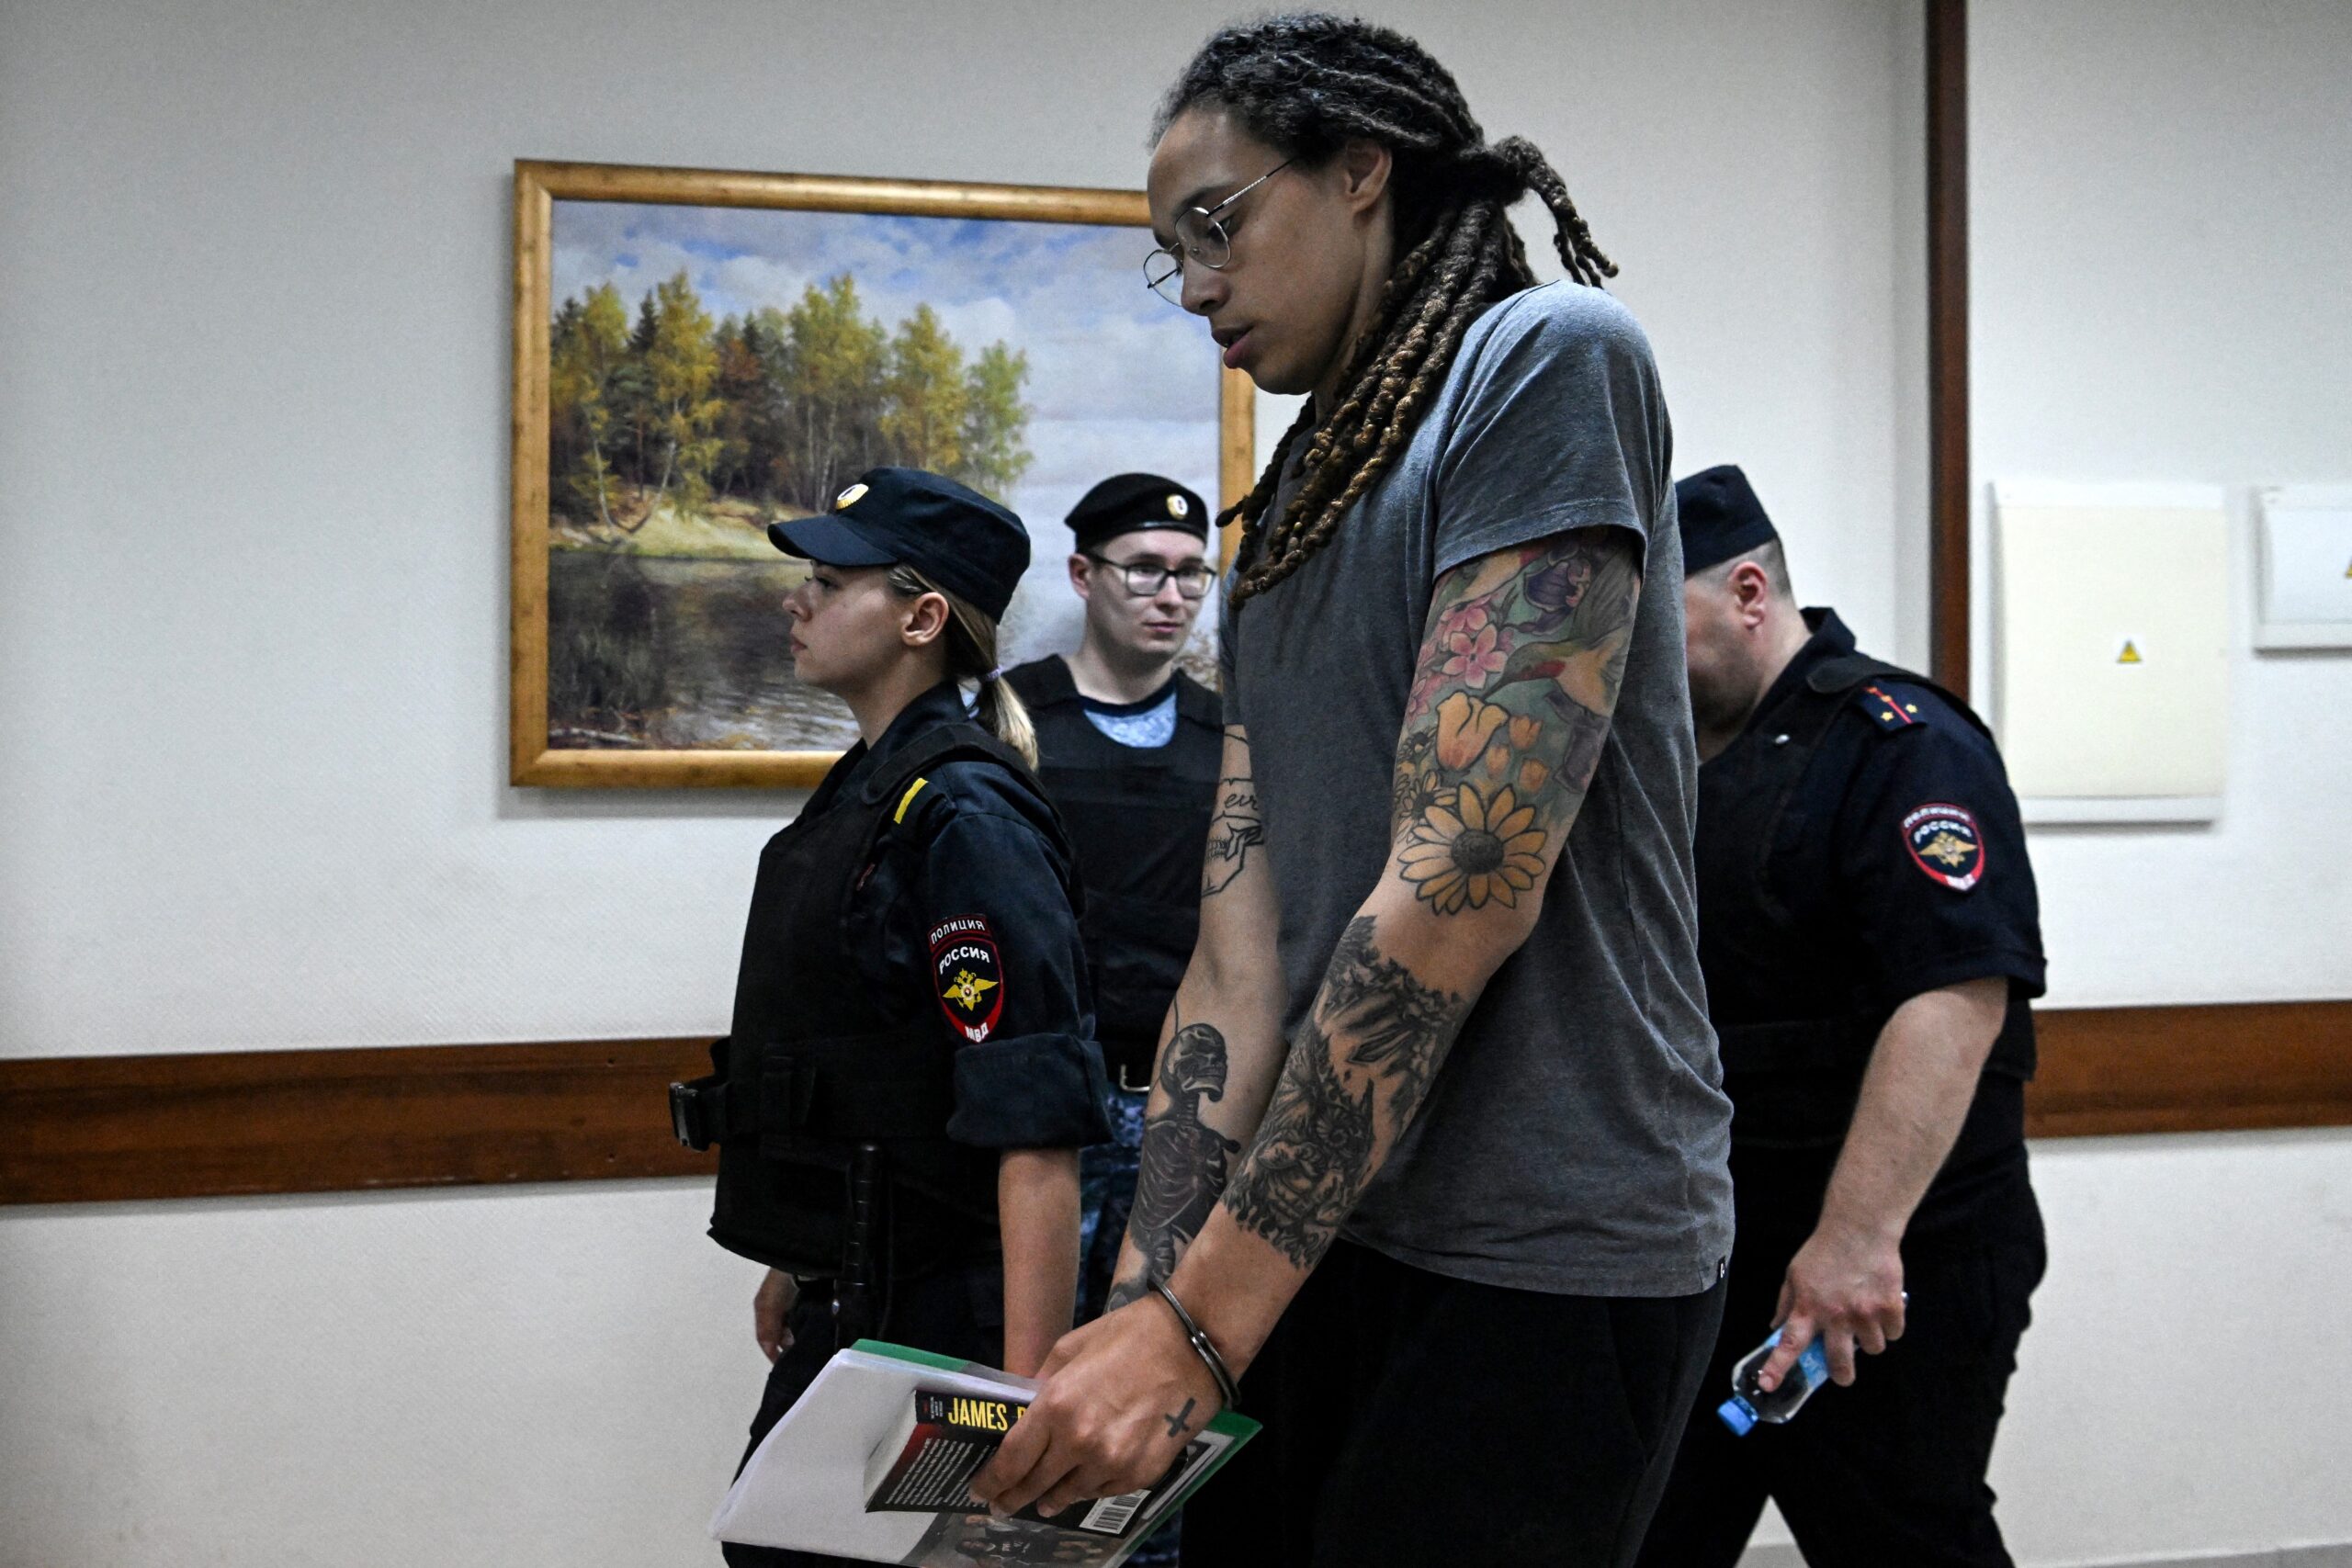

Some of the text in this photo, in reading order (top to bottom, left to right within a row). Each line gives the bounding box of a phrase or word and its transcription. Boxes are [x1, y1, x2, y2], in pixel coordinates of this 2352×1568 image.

[931, 919, 985, 944] ПОЛИЦИЯ
[939, 947, 990, 975] РОССИЯ
[965, 1021, 989, 1043] МВД
[948, 1397, 1009, 1431] JAMES
